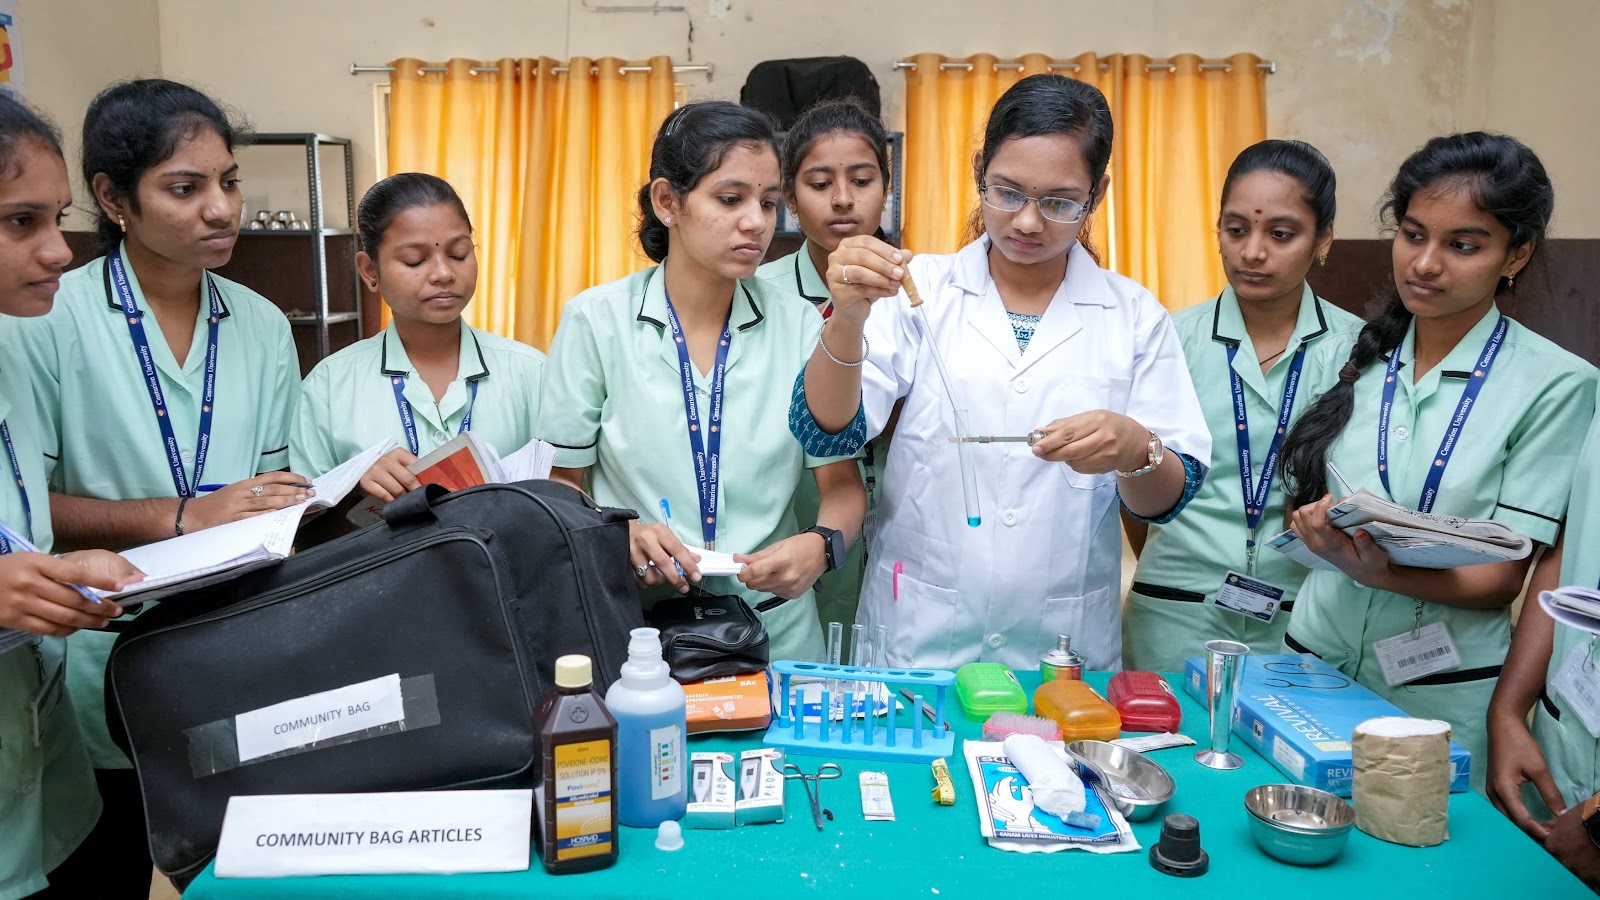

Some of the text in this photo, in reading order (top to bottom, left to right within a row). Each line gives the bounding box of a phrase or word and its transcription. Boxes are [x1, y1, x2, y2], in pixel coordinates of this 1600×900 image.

[113, 257, 136, 314] Centurion University
[140, 345, 163, 406] Centurion University
[206, 343, 217, 402] Centurion University
[1480, 338, 1498, 368] Centurion
[401, 401, 413, 427] University
[683, 361, 697, 421] Centurion University
[712, 363, 725, 421] Centurion University
[1236, 394, 1245, 420] Centurion
[1280, 370, 1299, 425] Centurion University
[197, 433, 209, 463] University
[1379, 401, 1391, 460] Centurion University
[1440, 396, 1473, 456] Centurion University
[167, 436, 188, 496] Centurion University
[696, 451, 706, 482] University
[708, 453, 719, 513] Centurion University
[1241, 448, 1253, 504] Centurion University
[1255, 452, 1278, 506] Centurion University
[1421, 486, 1436, 513] niversity
[273, 701, 372, 736] COMMUNITY BAG
[1257, 694, 1331, 741] REVIVAL
[1277, 693, 1342, 740] STETHOSCOPE
[557, 755, 608, 769] POVIDONE-IODINE
[559, 767, 607, 780] SOLUTION IP 5%
[1327, 768, 1354, 778] REVI
[256, 827, 483, 847] COMMUNITY BAG ARTICLES
[1038, 834, 1071, 842] INDUSTRIES
